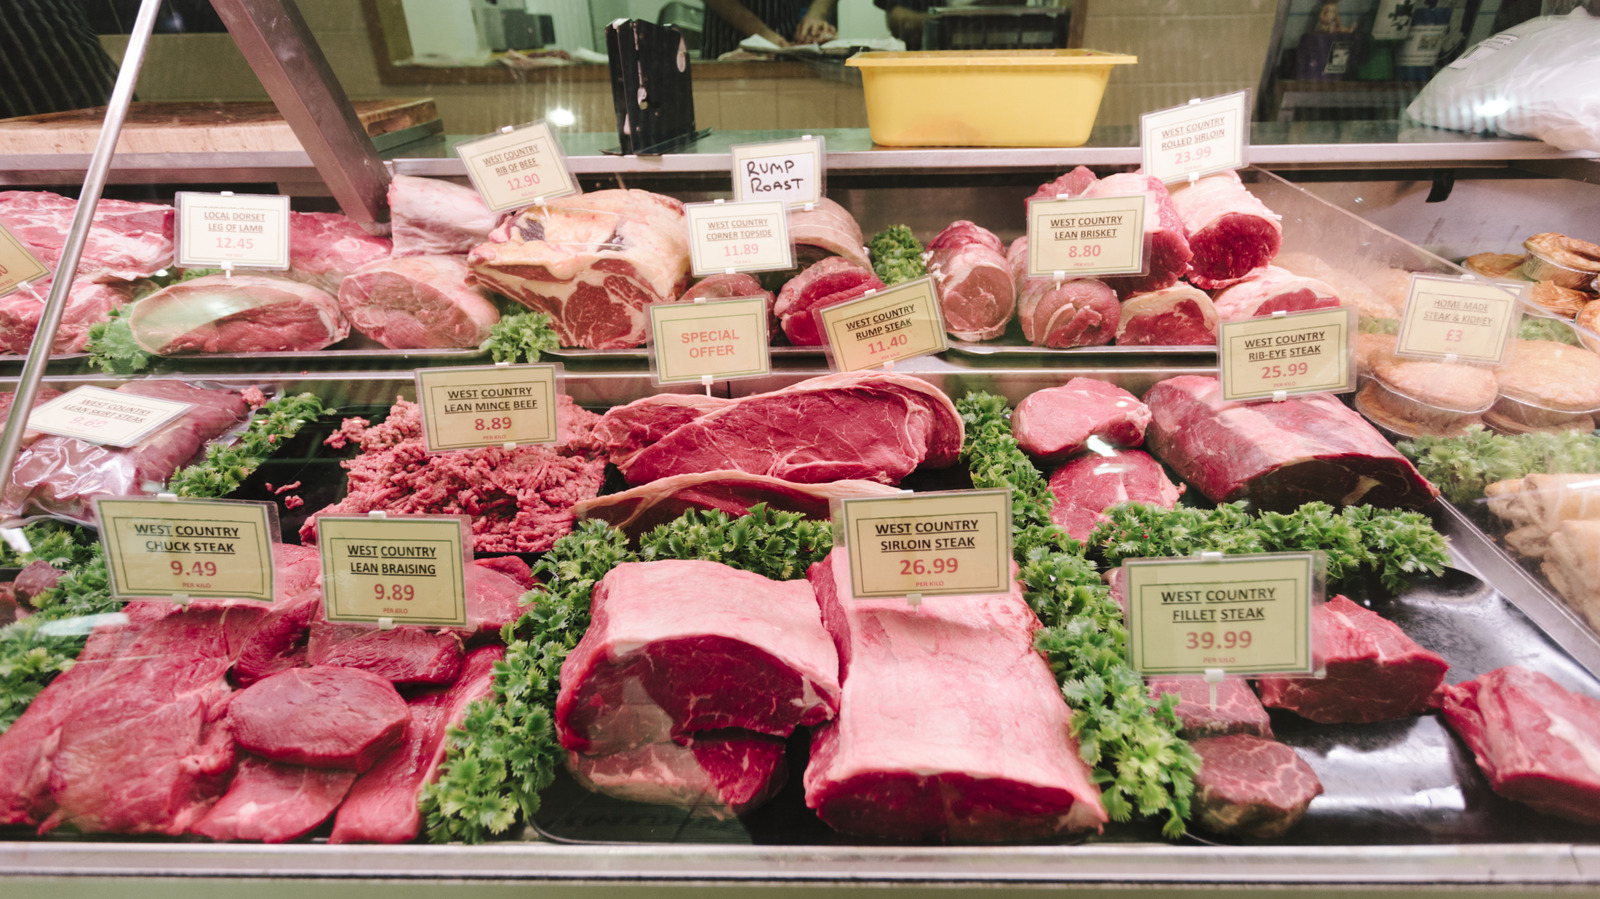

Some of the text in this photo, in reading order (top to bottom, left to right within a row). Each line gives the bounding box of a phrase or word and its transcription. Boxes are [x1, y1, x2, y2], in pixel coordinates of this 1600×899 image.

[1161, 116, 1225, 139] WEST COUNTRY
[1161, 129, 1225, 152] ROLLED SIRLOIN
[482, 144, 540, 167] WEST COUNTRY
[1175, 146, 1211, 164] 23.99
[495, 158, 538, 176] RIB OF BEEF
[747, 160, 794, 177] RUMP
[507, 173, 540, 191] 12.90
[751, 178, 804, 193] ROAST
[204, 211, 266, 222] LOCAL DORSET
[707, 218, 768, 230] WEST COUNTRY
[1050, 216, 1123, 228] WEST COUNTRY
[208, 223, 264, 233] LEG OF LAMB
[706, 229, 773, 241] CORNER TOPSIDE
[1054, 228, 1117, 241] LEAN BRISKET
[216, 237, 254, 249] 12.45
[724, 243, 759, 257] 11.89
[1068, 244, 1101, 258] 8.80
[1433, 299, 1489, 313] HOME MADE
[846, 304, 916, 332] WEST COUNTRY
[1423, 311, 1493, 327] STEAK & KIDNEY
[681, 329, 740, 344] SPECIAL
[856, 318, 912, 341] RUMP STEAK
[1445, 329, 1463, 342] £3
[867, 334, 908, 354] 11.40
[1245, 331, 1325, 350] WEST COUNTRY
[689, 344, 735, 358] OFFER
[1248, 345, 1321, 362] RIB-EYE STEAK
[1262, 362, 1308, 379] 25.99
[448, 387, 532, 400] WEST COUNTRY
[63, 404, 147, 424] LEAN SKIRT STEAK
[80, 399, 153, 416] WEST COUNTRY
[444, 400, 538, 414] LEAN MINCE BEEF
[474, 417, 512, 431] 8.89
[135, 524, 240, 539] WEST COUNTRY
[875, 519, 979, 536] WEST COUNTRY
[146, 541, 236, 554] CHUCK STEAK
[347, 545, 437, 559] WEST COUNTRY
[881, 537, 975, 553] SIRLOIN STEAK
[170, 560, 217, 577] 9.49
[350, 562, 437, 577] LEAN BRAISING
[900, 557, 958, 575] 26.99
[374, 583, 415, 601] 9.89
[1161, 587, 1276, 605] WEST COUNTRY
[1172, 607, 1265, 623] FILLET STEAK
[1186, 630, 1252, 649] 39.99
